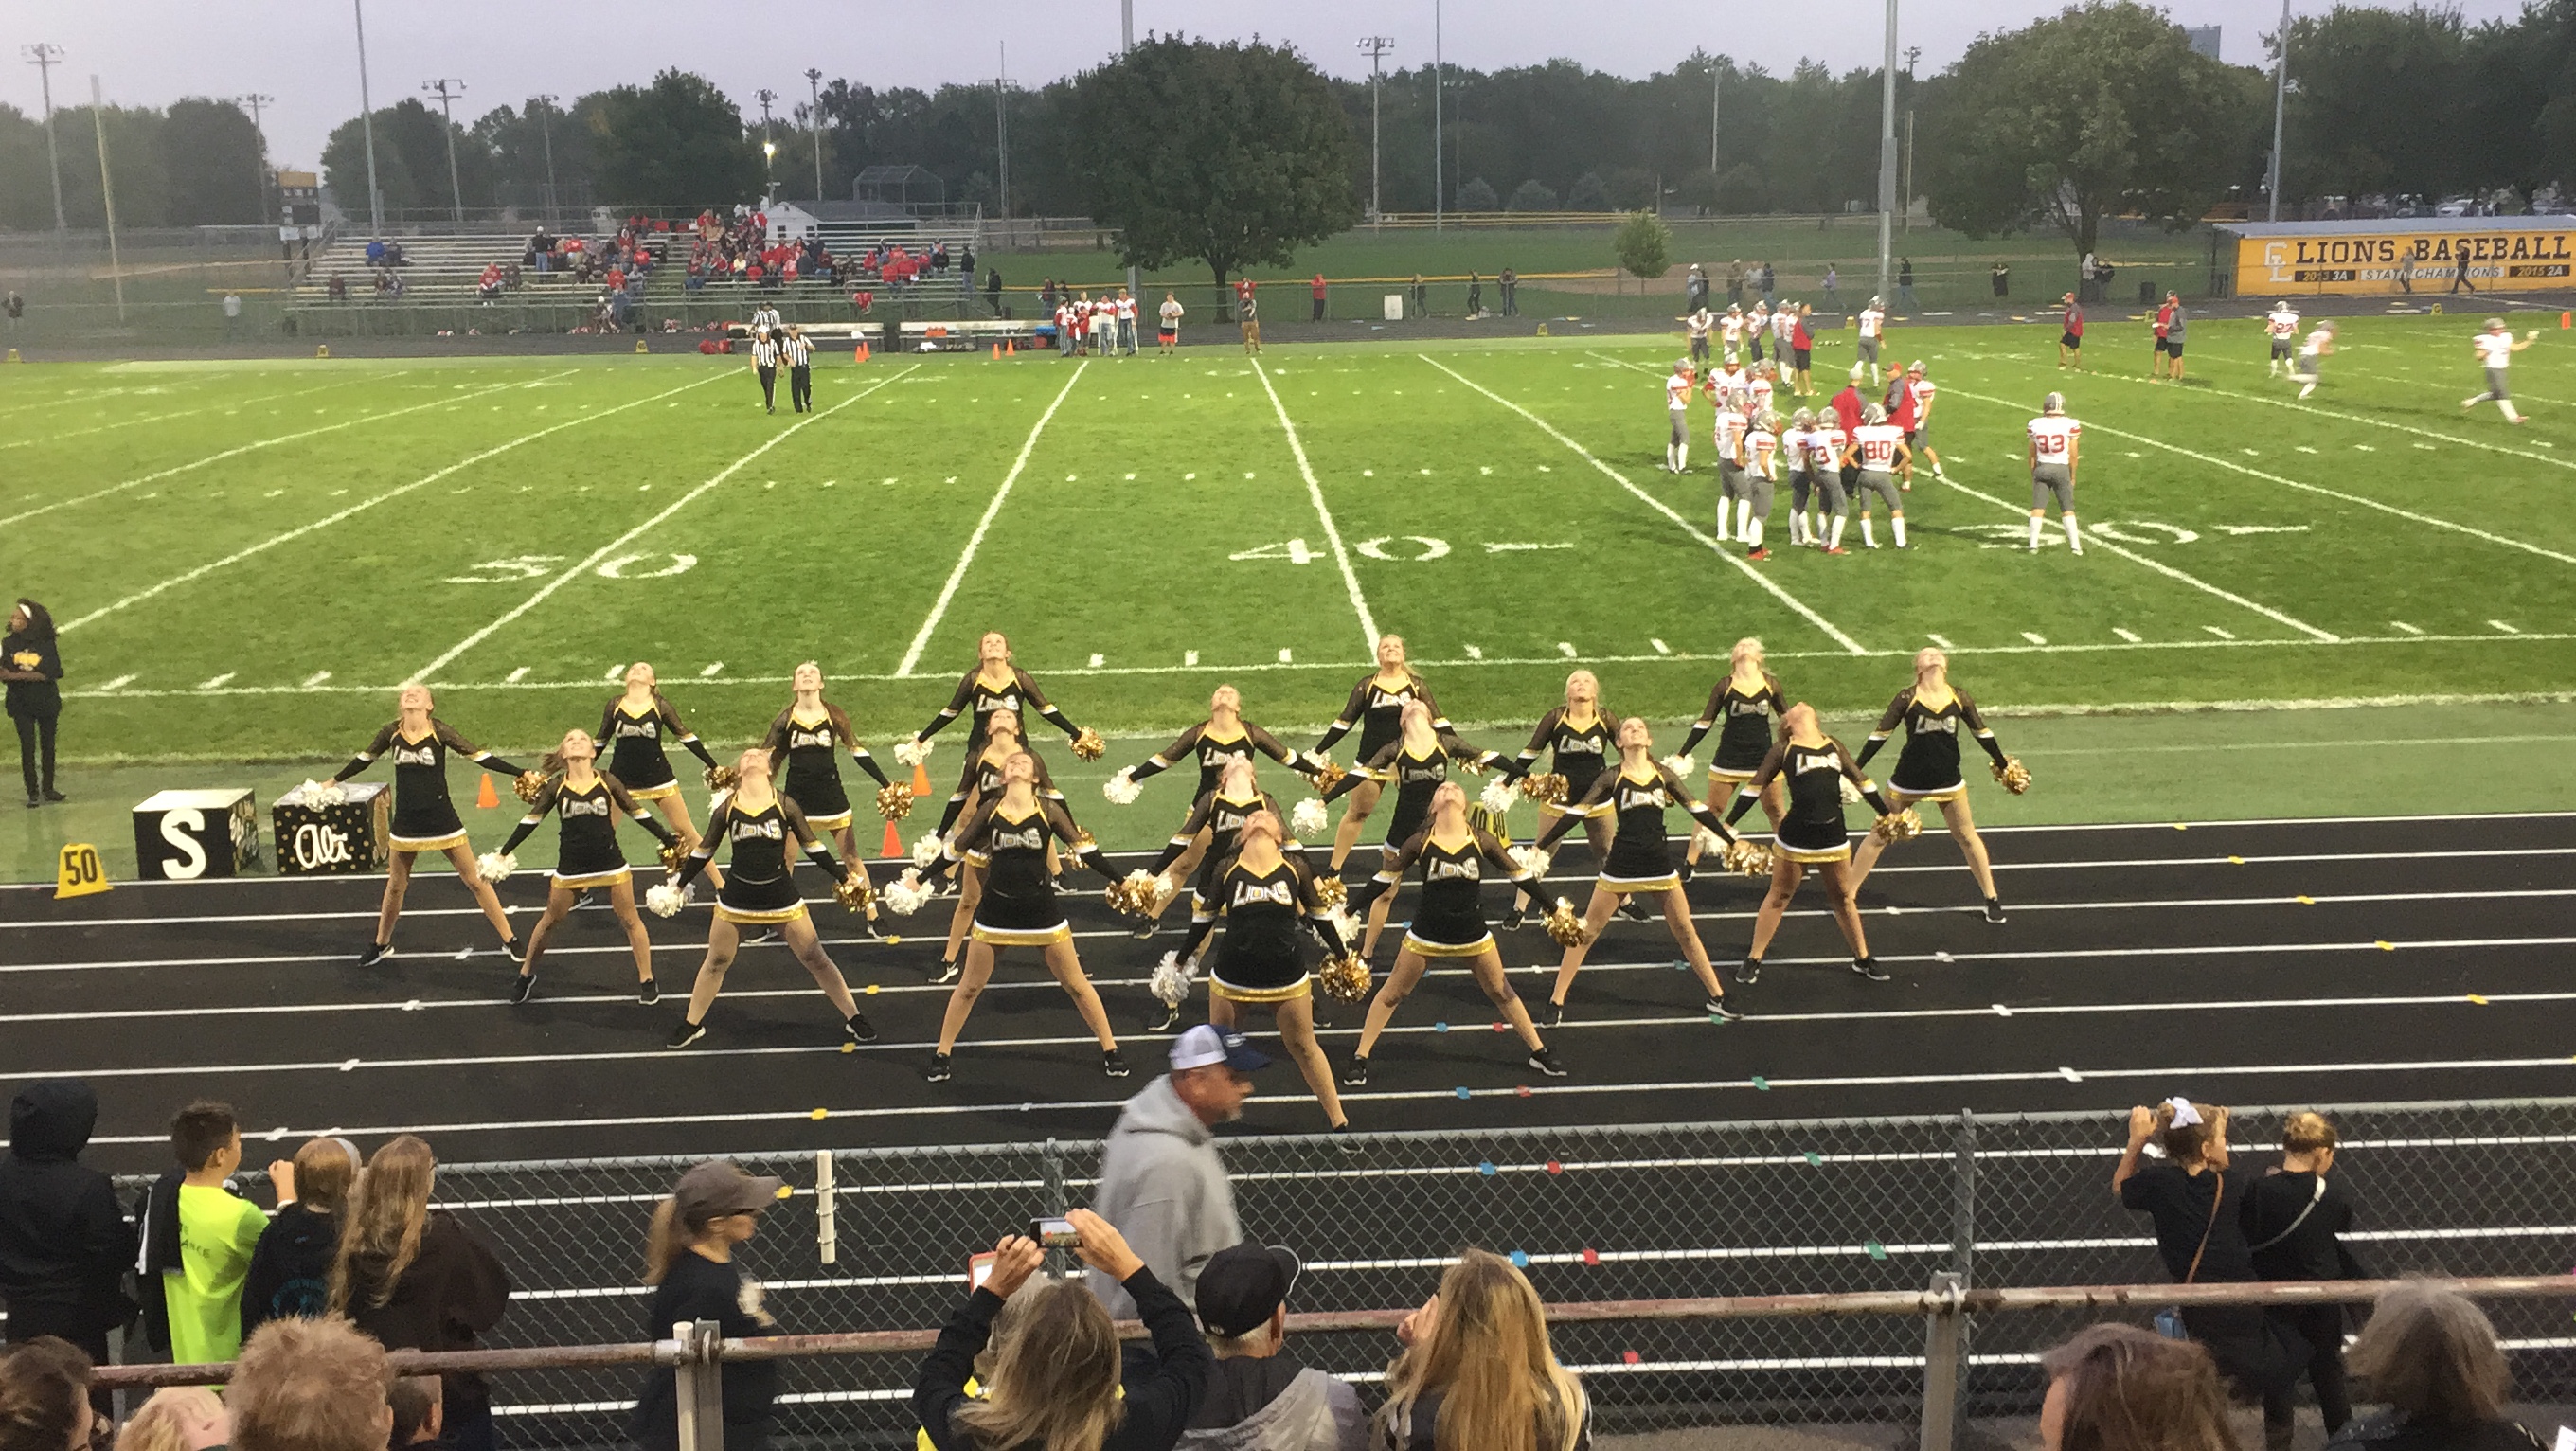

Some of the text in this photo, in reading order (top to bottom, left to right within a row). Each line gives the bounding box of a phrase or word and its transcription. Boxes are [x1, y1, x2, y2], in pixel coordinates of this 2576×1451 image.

[2296, 236, 2571, 264] LIONS BASEBALL
[2332, 270, 2348, 281] 3A
[2366, 267, 2499, 280] STAT CHAMIONS
[2517, 266, 2563, 277] 2015 2A
[1864, 440, 1891, 460] 80
[2036, 435, 2065, 454] 33
[1228, 535, 1451, 565] 40
[979, 693, 1019, 712] LIONS
[1730, 699, 1769, 717] LIONS
[616, 719, 656, 739] LIONS
[1915, 714, 1957, 734] LIONS
[790, 729, 831, 749] LIONS
[1558, 734, 1602, 754] LIONS
[394, 744, 436, 766] LIONS
[1795, 751, 1841, 776] LIONS
[1402, 762, 1444, 783] LIONS
[562, 796, 608, 819] LIONS
[1622, 787, 1666, 811] LIONS
[731, 818, 782, 842] LIONS
[991, 827, 1041, 851] LIONS
[159, 808, 206, 881] S
[64, 848, 98, 887] 50
[1426, 856, 1479, 882] LIONS
[1231, 880, 1293, 908] LIONS
